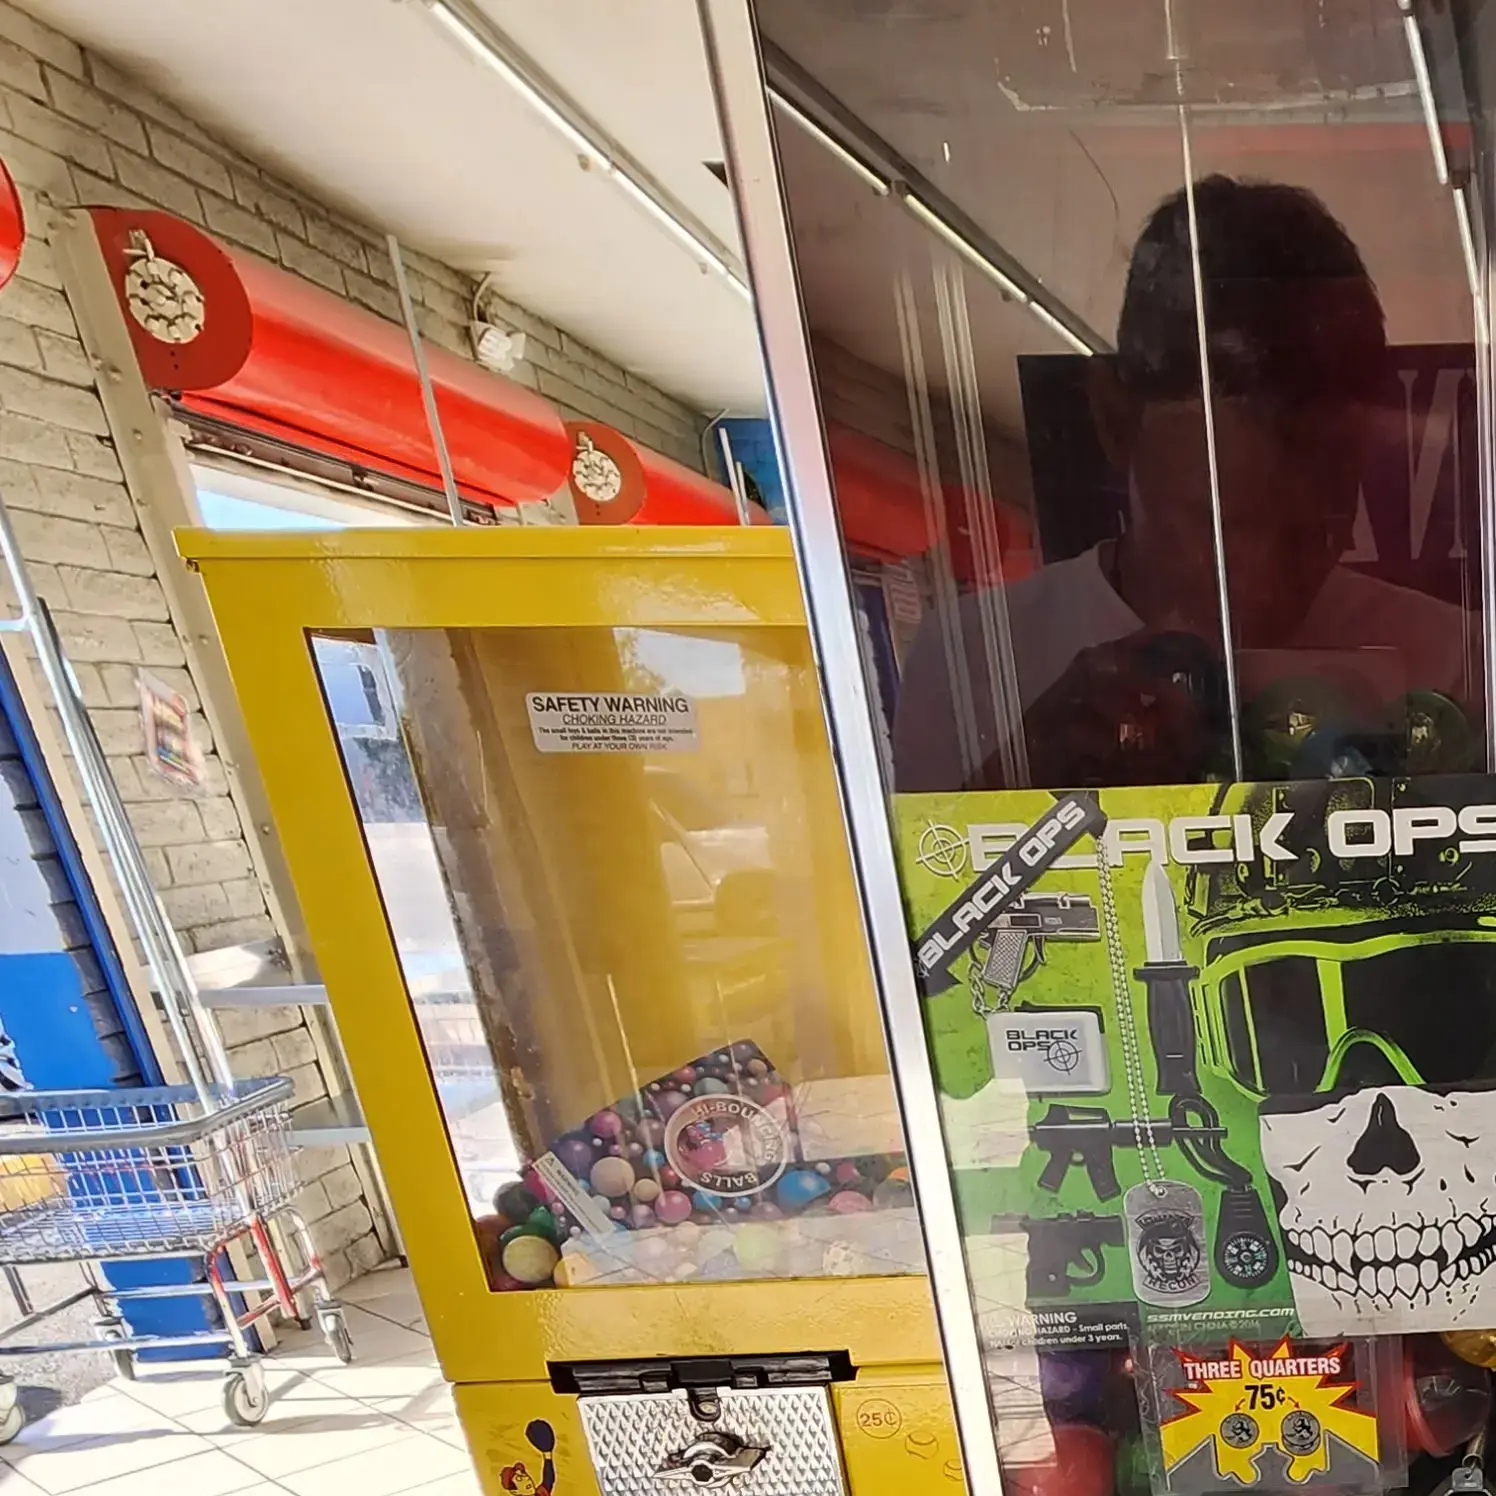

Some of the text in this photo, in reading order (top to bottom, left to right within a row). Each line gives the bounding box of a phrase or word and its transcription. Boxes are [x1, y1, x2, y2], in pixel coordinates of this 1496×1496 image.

[532, 697, 689, 713] SAFETY WARNING
[562, 714, 667, 725] CHOKING HAZARD
[918, 800, 1087, 970] BLACK OPS
[1006, 1029, 1077, 1040] BLACK
[1008, 1041, 1050, 1051] OPS
[701, 1171, 757, 1188] BALLS
[1078, 1324, 1103, 1332] Small
[1060, 1334, 1086, 1343] under
[1184, 1357, 1341, 1380] THREE QUARTERS
[1245, 1384, 1286, 1410] 75¢
